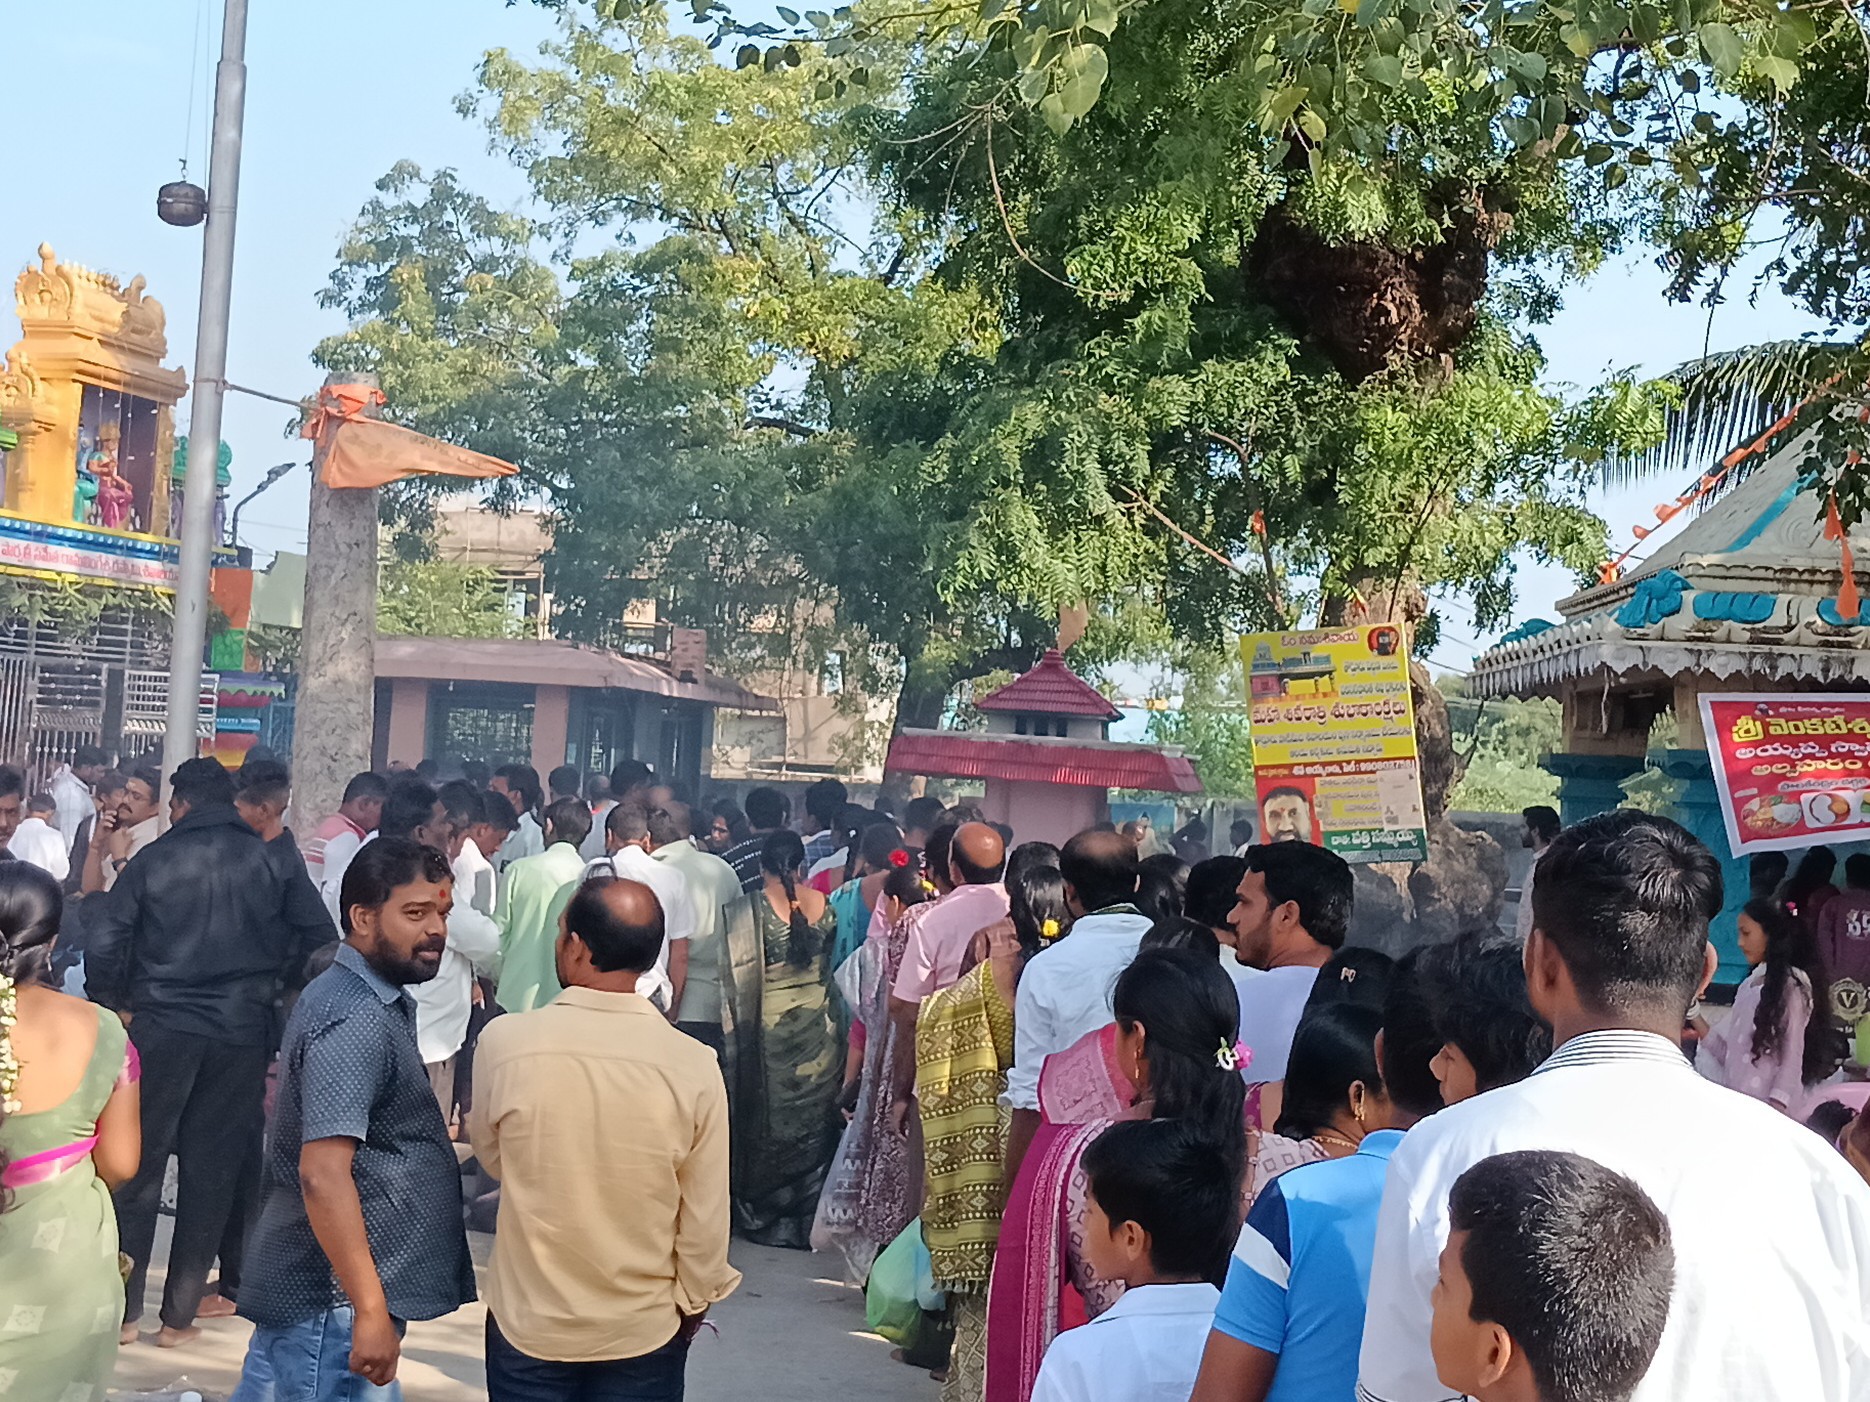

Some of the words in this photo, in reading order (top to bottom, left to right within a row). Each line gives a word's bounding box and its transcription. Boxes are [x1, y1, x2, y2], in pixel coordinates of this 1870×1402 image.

[1281, 635, 1296, 647] ఓం
[1253, 706, 1280, 724] మహా
[1284, 705, 1327, 726] శివరాత్రి
[1330, 700, 1405, 723] శుభాకాంక్షలు
[1732, 715, 1764, 742] శ్రీ
[1735, 741, 1829, 759] అయ్యప్ప
[1830, 741, 1870, 757] స్వా
[1840, 991, 1856, 1008] V
